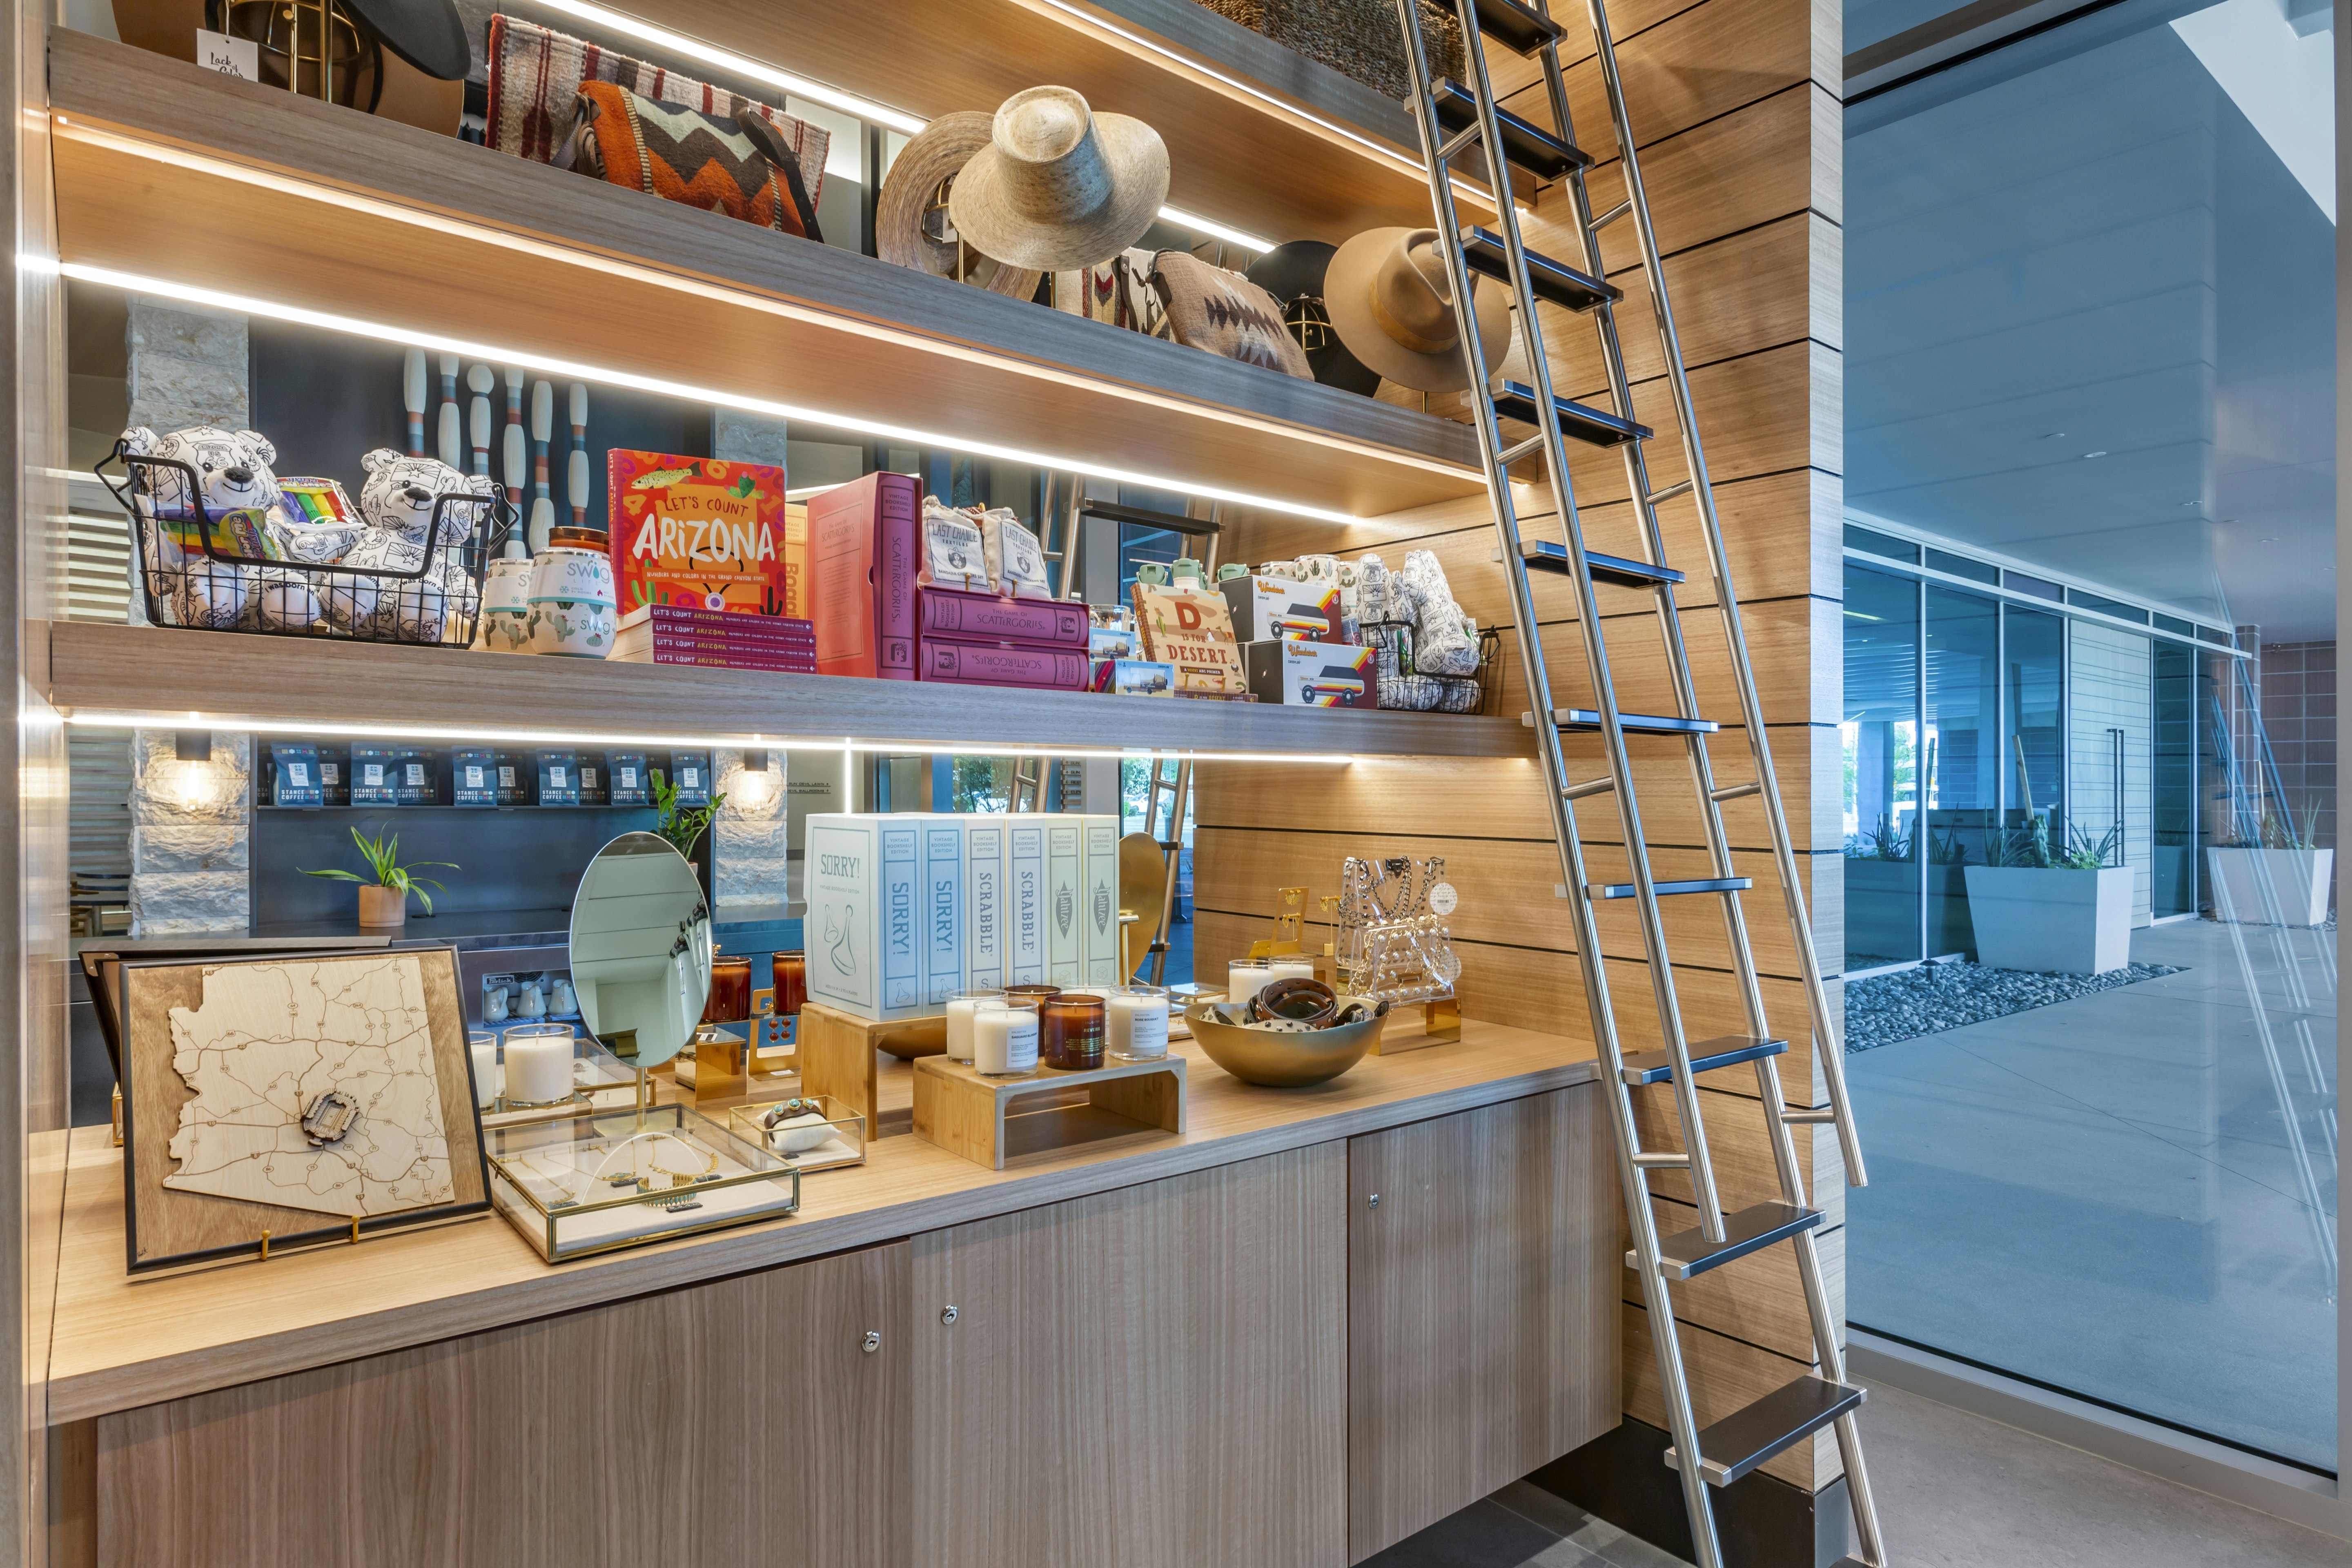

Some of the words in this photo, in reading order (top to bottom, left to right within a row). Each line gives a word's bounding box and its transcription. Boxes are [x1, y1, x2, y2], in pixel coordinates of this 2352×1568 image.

[211, 51, 232, 66] Lack
[205, 457, 229, 467] 66
[664, 496, 699, 511] LET'S
[707, 498, 748, 517] COUNT
[932, 523, 951, 537] LAST
[952, 526, 978, 542] CHANCE
[942, 539, 968, 547] TEXTILES
[1005, 526, 1019, 541] LAST
[1020, 535, 1037, 553] CHANCE
[1007, 570, 1022, 578] BANDANA
[285, 582, 305, 590] born
[694, 613, 723, 621] ARIZONA
[1174, 602, 1201, 630] D
[1191, 634, 1206, 643] FOR
[1167, 645, 1227, 664] DESERT
[821, 854, 860, 878] SORRY!
[936, 881, 952, 951] SORRY!
[980, 873, 993, 953] SCRABBLE
[1021, 872, 1034, 951] SCRABBLE
[1055, 889, 1074, 929] Yahtzee
[1093, 886, 1111, 927] Yahtzee
[892, 882, 909, 955] SORRY!
